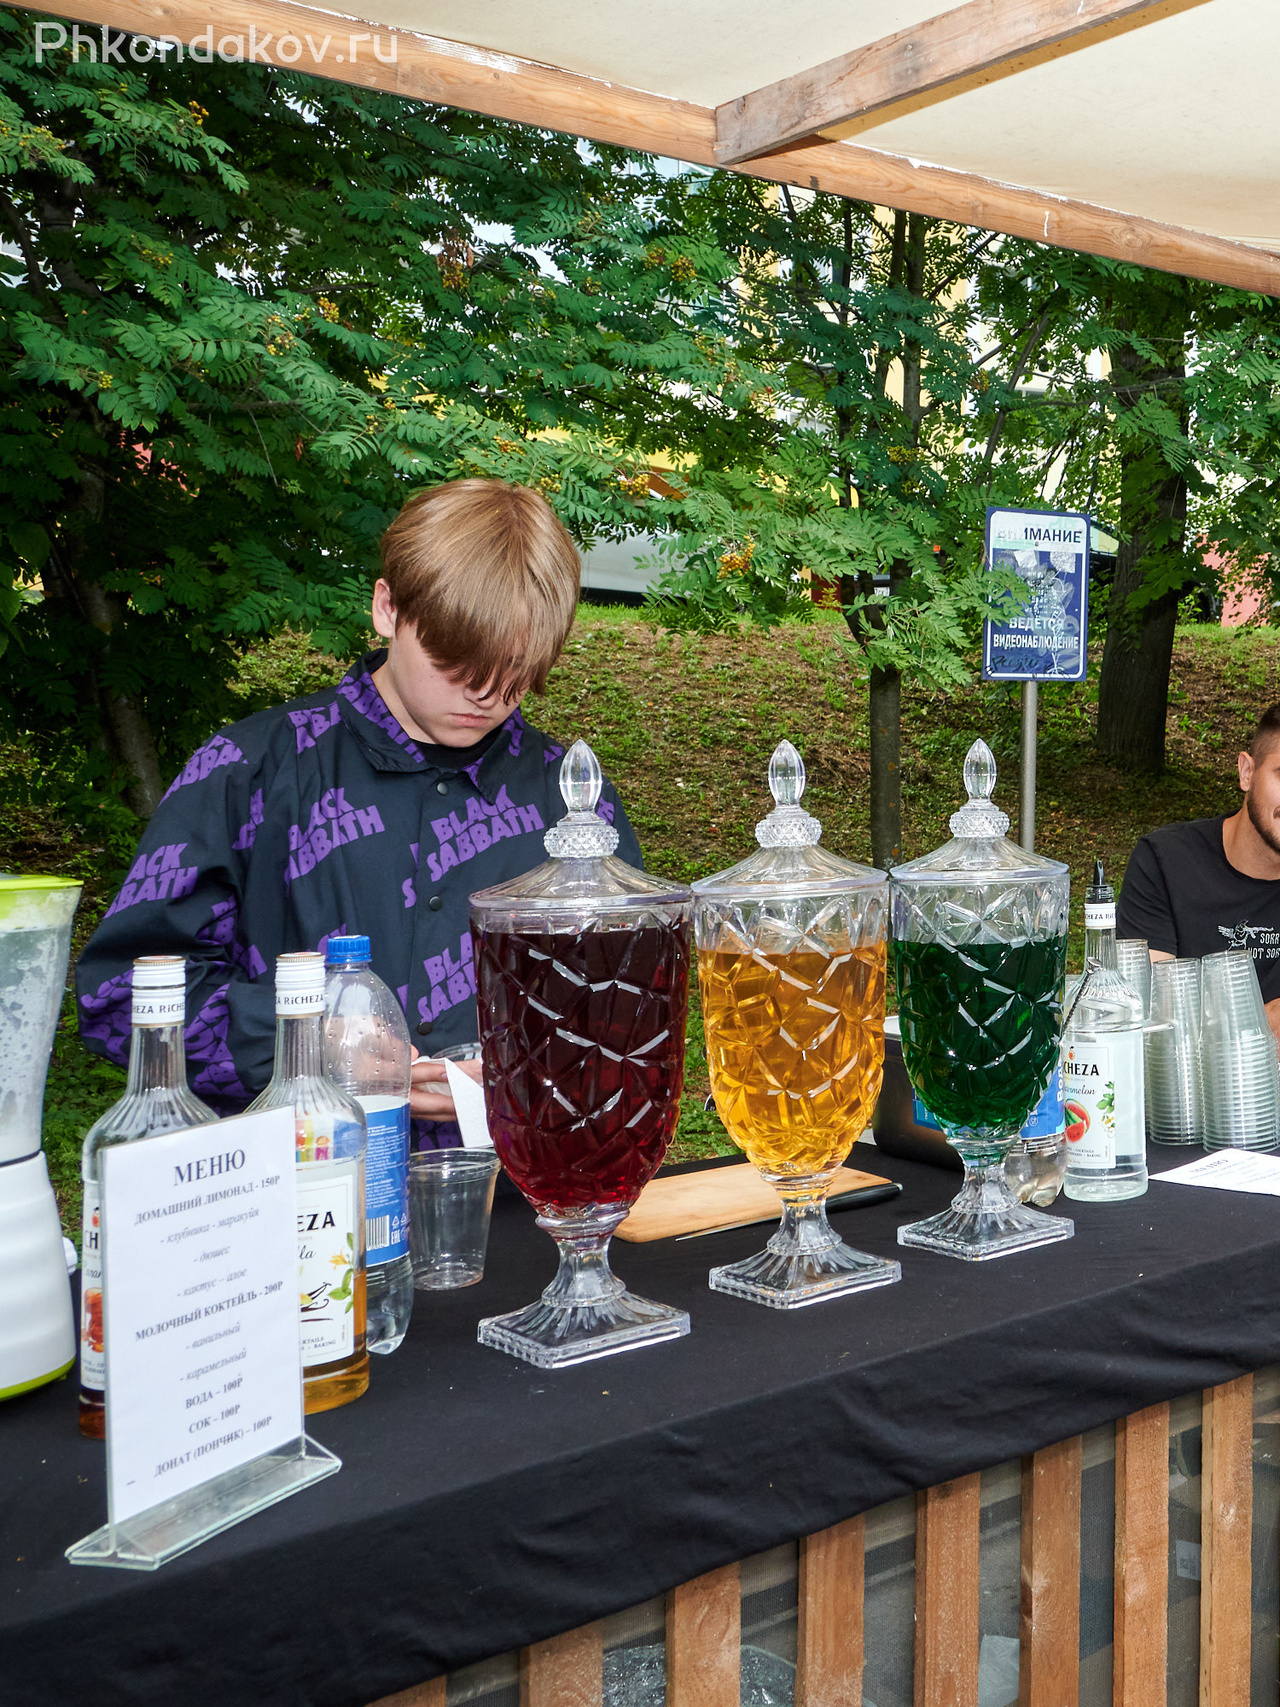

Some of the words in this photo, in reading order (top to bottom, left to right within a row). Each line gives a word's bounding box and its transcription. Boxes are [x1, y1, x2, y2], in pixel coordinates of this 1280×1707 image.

[993, 633, 1080, 649] ВИДЕОНАБЛЮДЕНИЕ
[426, 803, 545, 882] SABBATH
[173, 1149, 246, 1187] МЕНЮ
[134, 1195, 202, 1226] ДОМАШНИЙ
[203, 1182, 254, 1206] ЛИМОНАД
[261, 1175, 281, 1189] 150Р
[166, 1224, 210, 1244] клубника
[183, 1279, 217, 1297] кактус
[226, 1268, 248, 1283] алое
[135, 1309, 202, 1342] МОЛОЧНЫЙ
[204, 1291, 257, 1318] КОКТЕЙЛЬ
[264, 1281, 284, 1296] 200Р
[191, 1321, 242, 1350] ванильный
[185, 1348, 247, 1381] карамельный
[185, 1391, 213, 1410] ВОДА
[223, 1377, 243, 1394] 100Р
[188, 1415, 211, 1434] СОК
[220, 1404, 241, 1421] 100Р
[153, 1451, 191, 1478] ДОНАТ
[253, 1416, 273, 1432] 100Р
